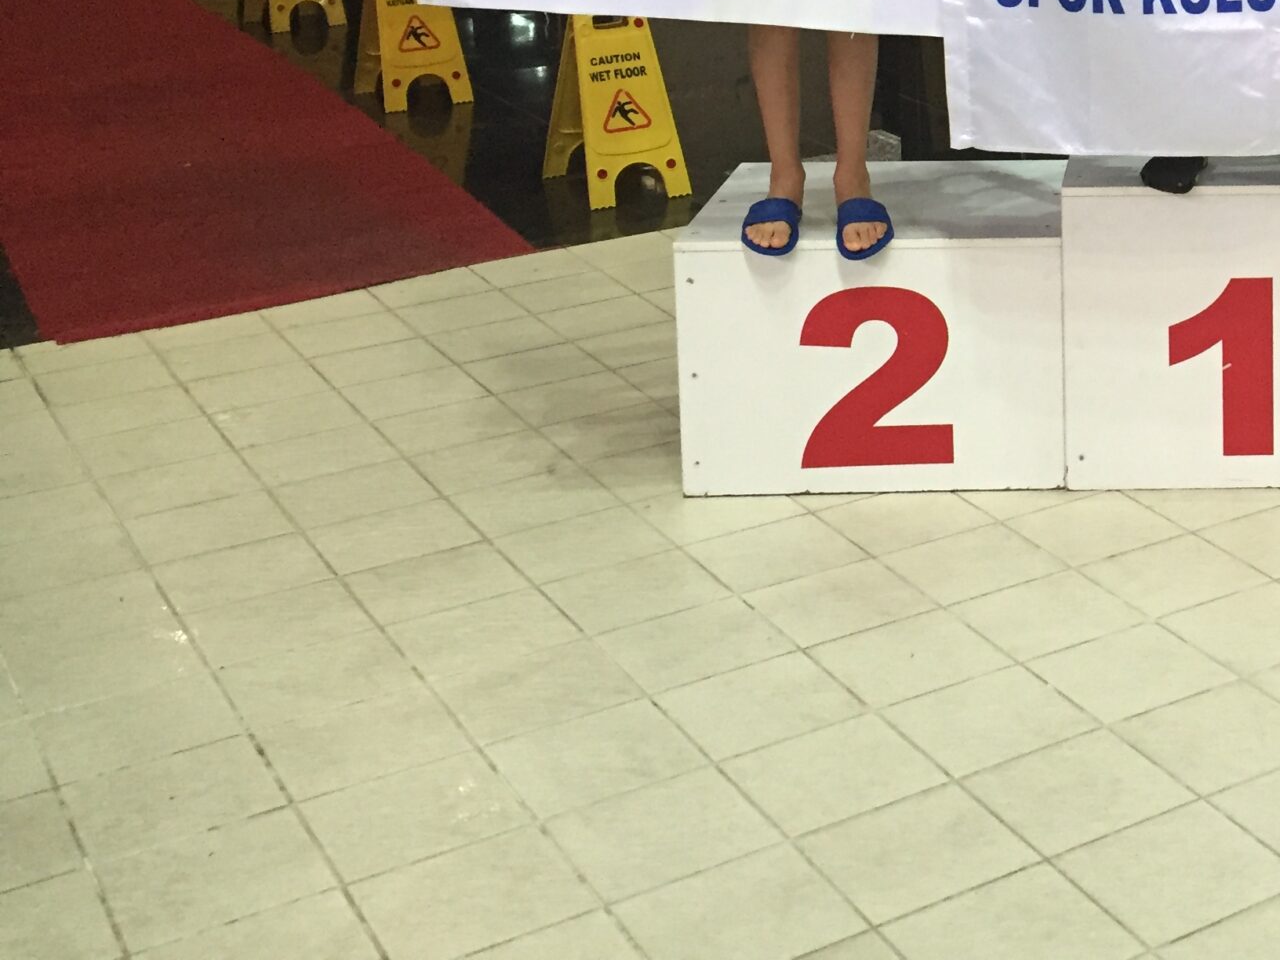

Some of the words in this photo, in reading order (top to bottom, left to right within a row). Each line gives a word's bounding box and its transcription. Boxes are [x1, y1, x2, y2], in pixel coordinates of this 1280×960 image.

[589, 69, 611, 82] WET
[613, 65, 648, 80] FLOOR
[590, 51, 641, 67] CAUTION
[800, 286, 954, 469] 2
[1168, 277, 1275, 457] 1
